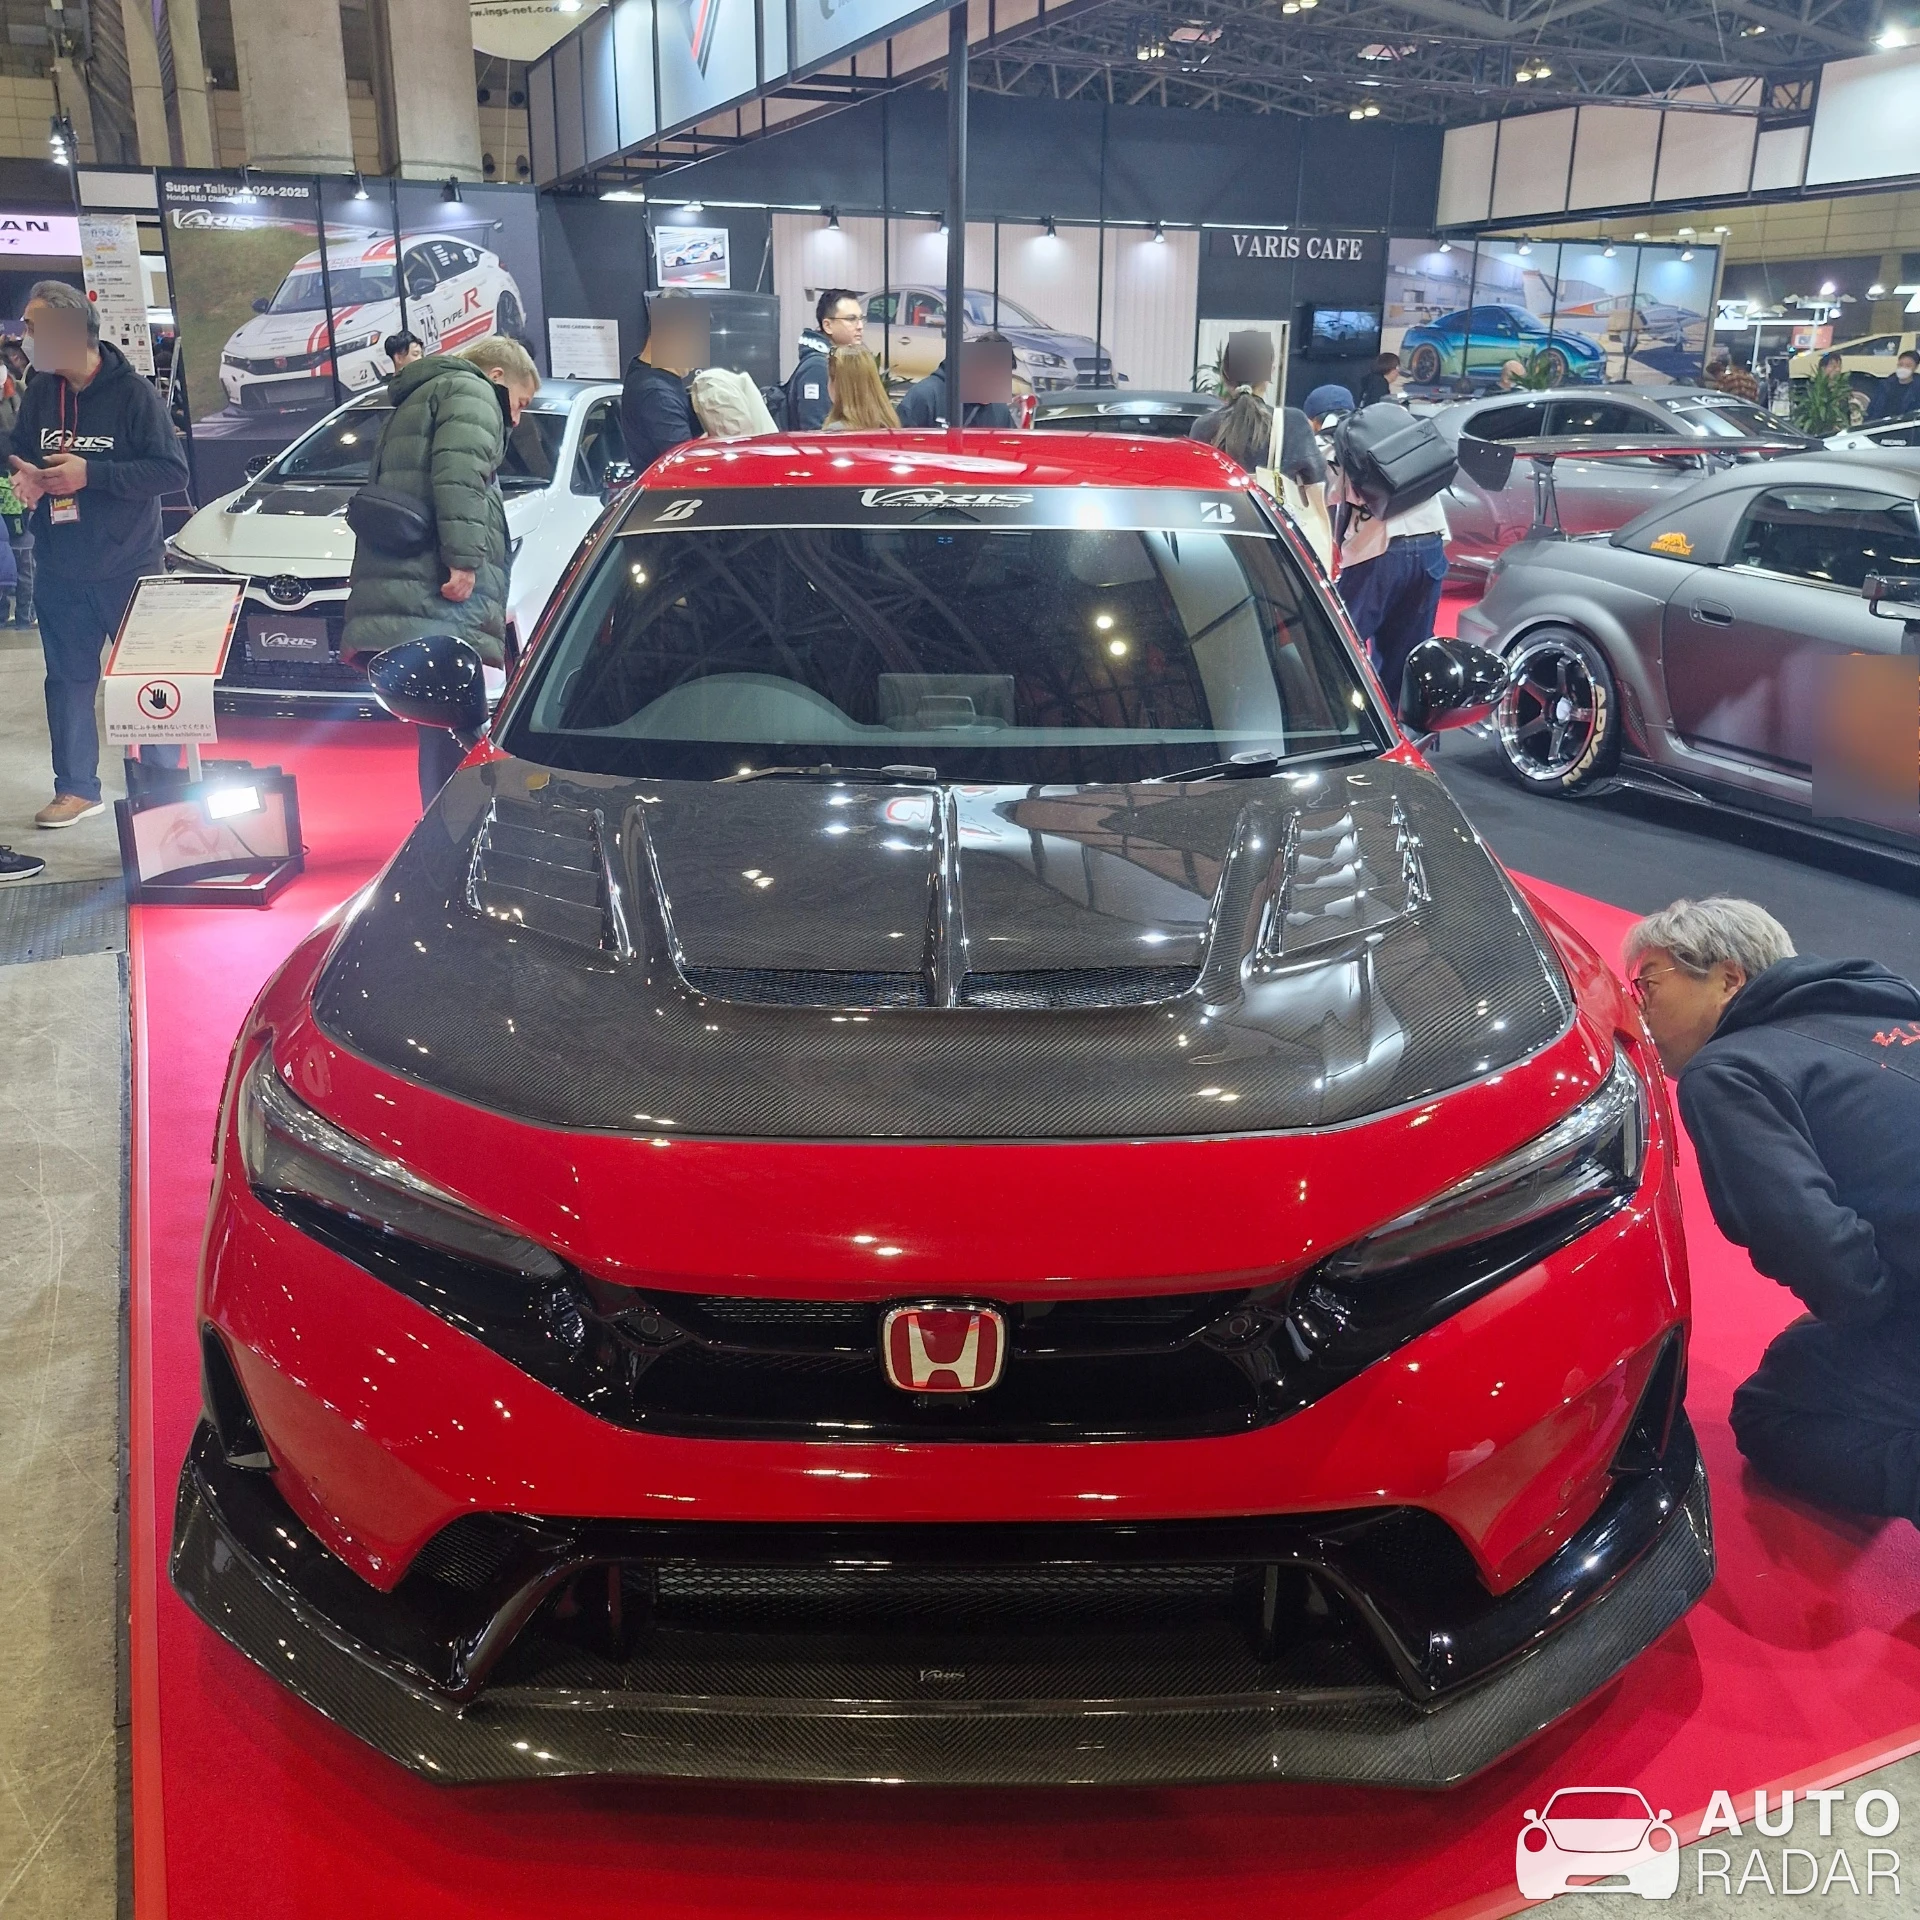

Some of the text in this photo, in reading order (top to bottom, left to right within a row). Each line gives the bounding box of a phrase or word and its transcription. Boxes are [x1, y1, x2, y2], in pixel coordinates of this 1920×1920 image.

[165, 181, 201, 194] Super
[245, 186, 309, 198] 024-2025
[1232, 234, 1363, 261] VARIS CAFE
[442, 287, 482, 328] TYPE R
[858, 488, 1034, 507] VARIS
[259, 632, 317, 647] VARIS
[1561, 684, 1607, 787] ADVAN
